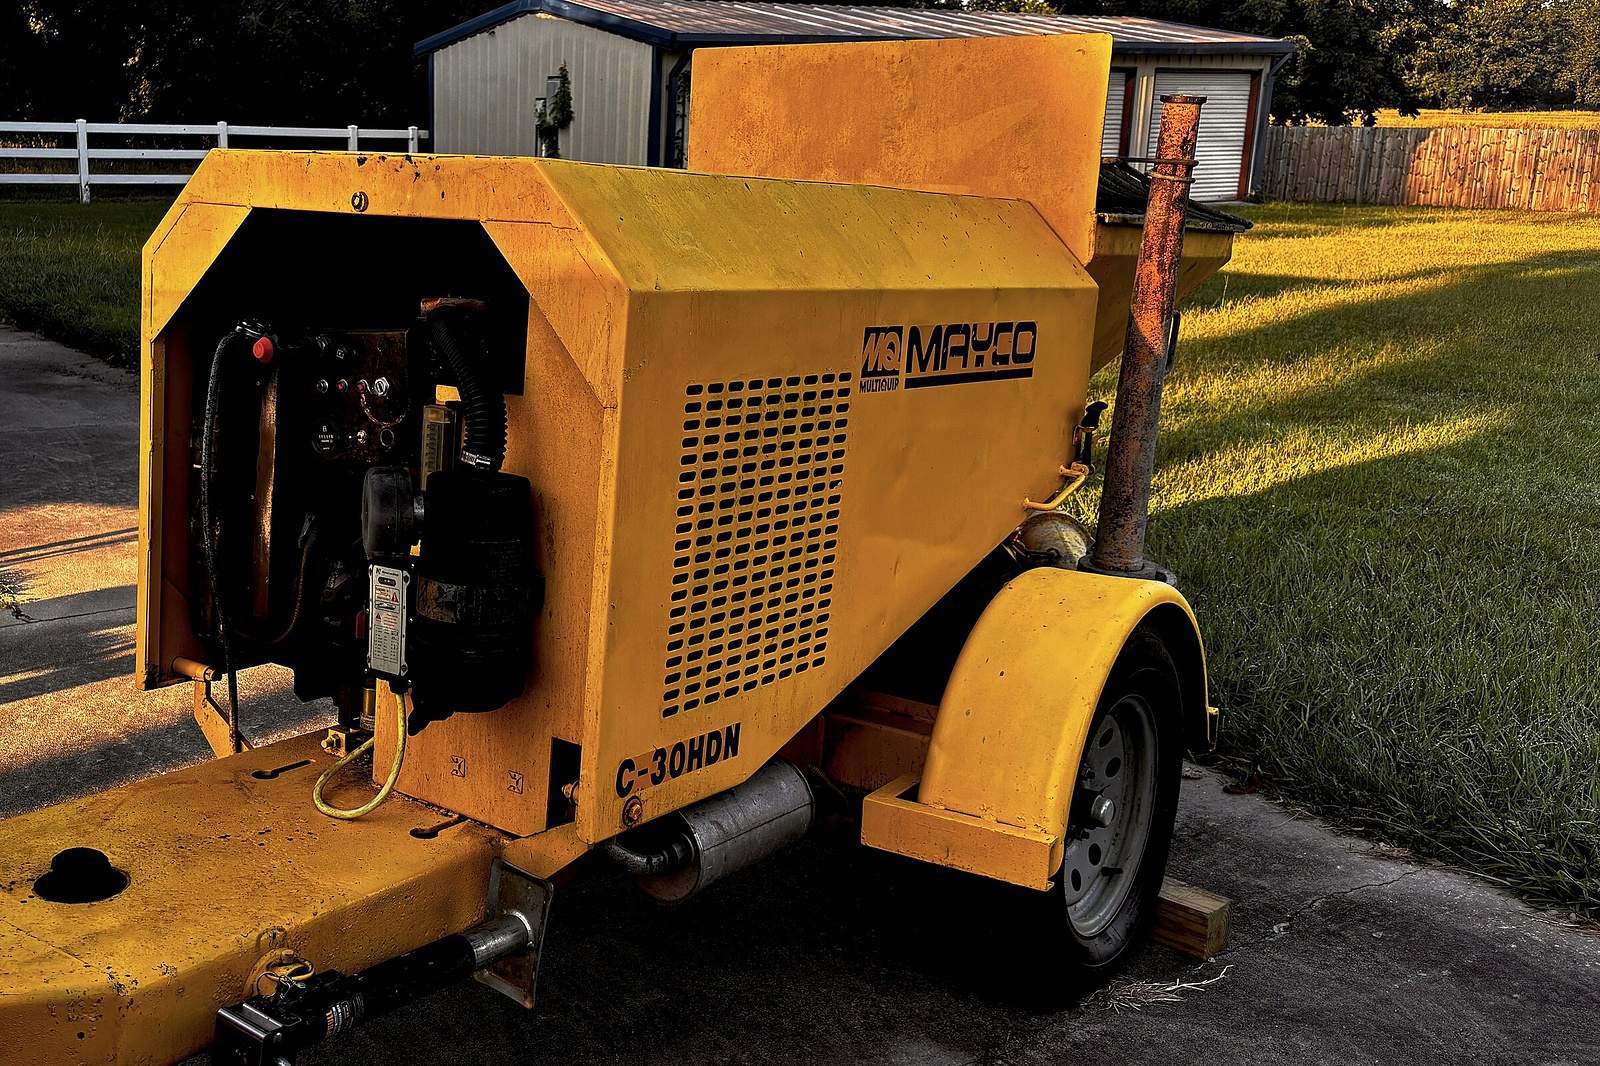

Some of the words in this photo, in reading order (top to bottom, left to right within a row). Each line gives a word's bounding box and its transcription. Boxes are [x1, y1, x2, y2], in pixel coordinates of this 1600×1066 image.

[862, 329, 901, 373] MQ
[905, 321, 1037, 373] MAYCO
[859, 378, 899, 393] MULTIQUIP
[616, 722, 741, 798] C-30HDN
